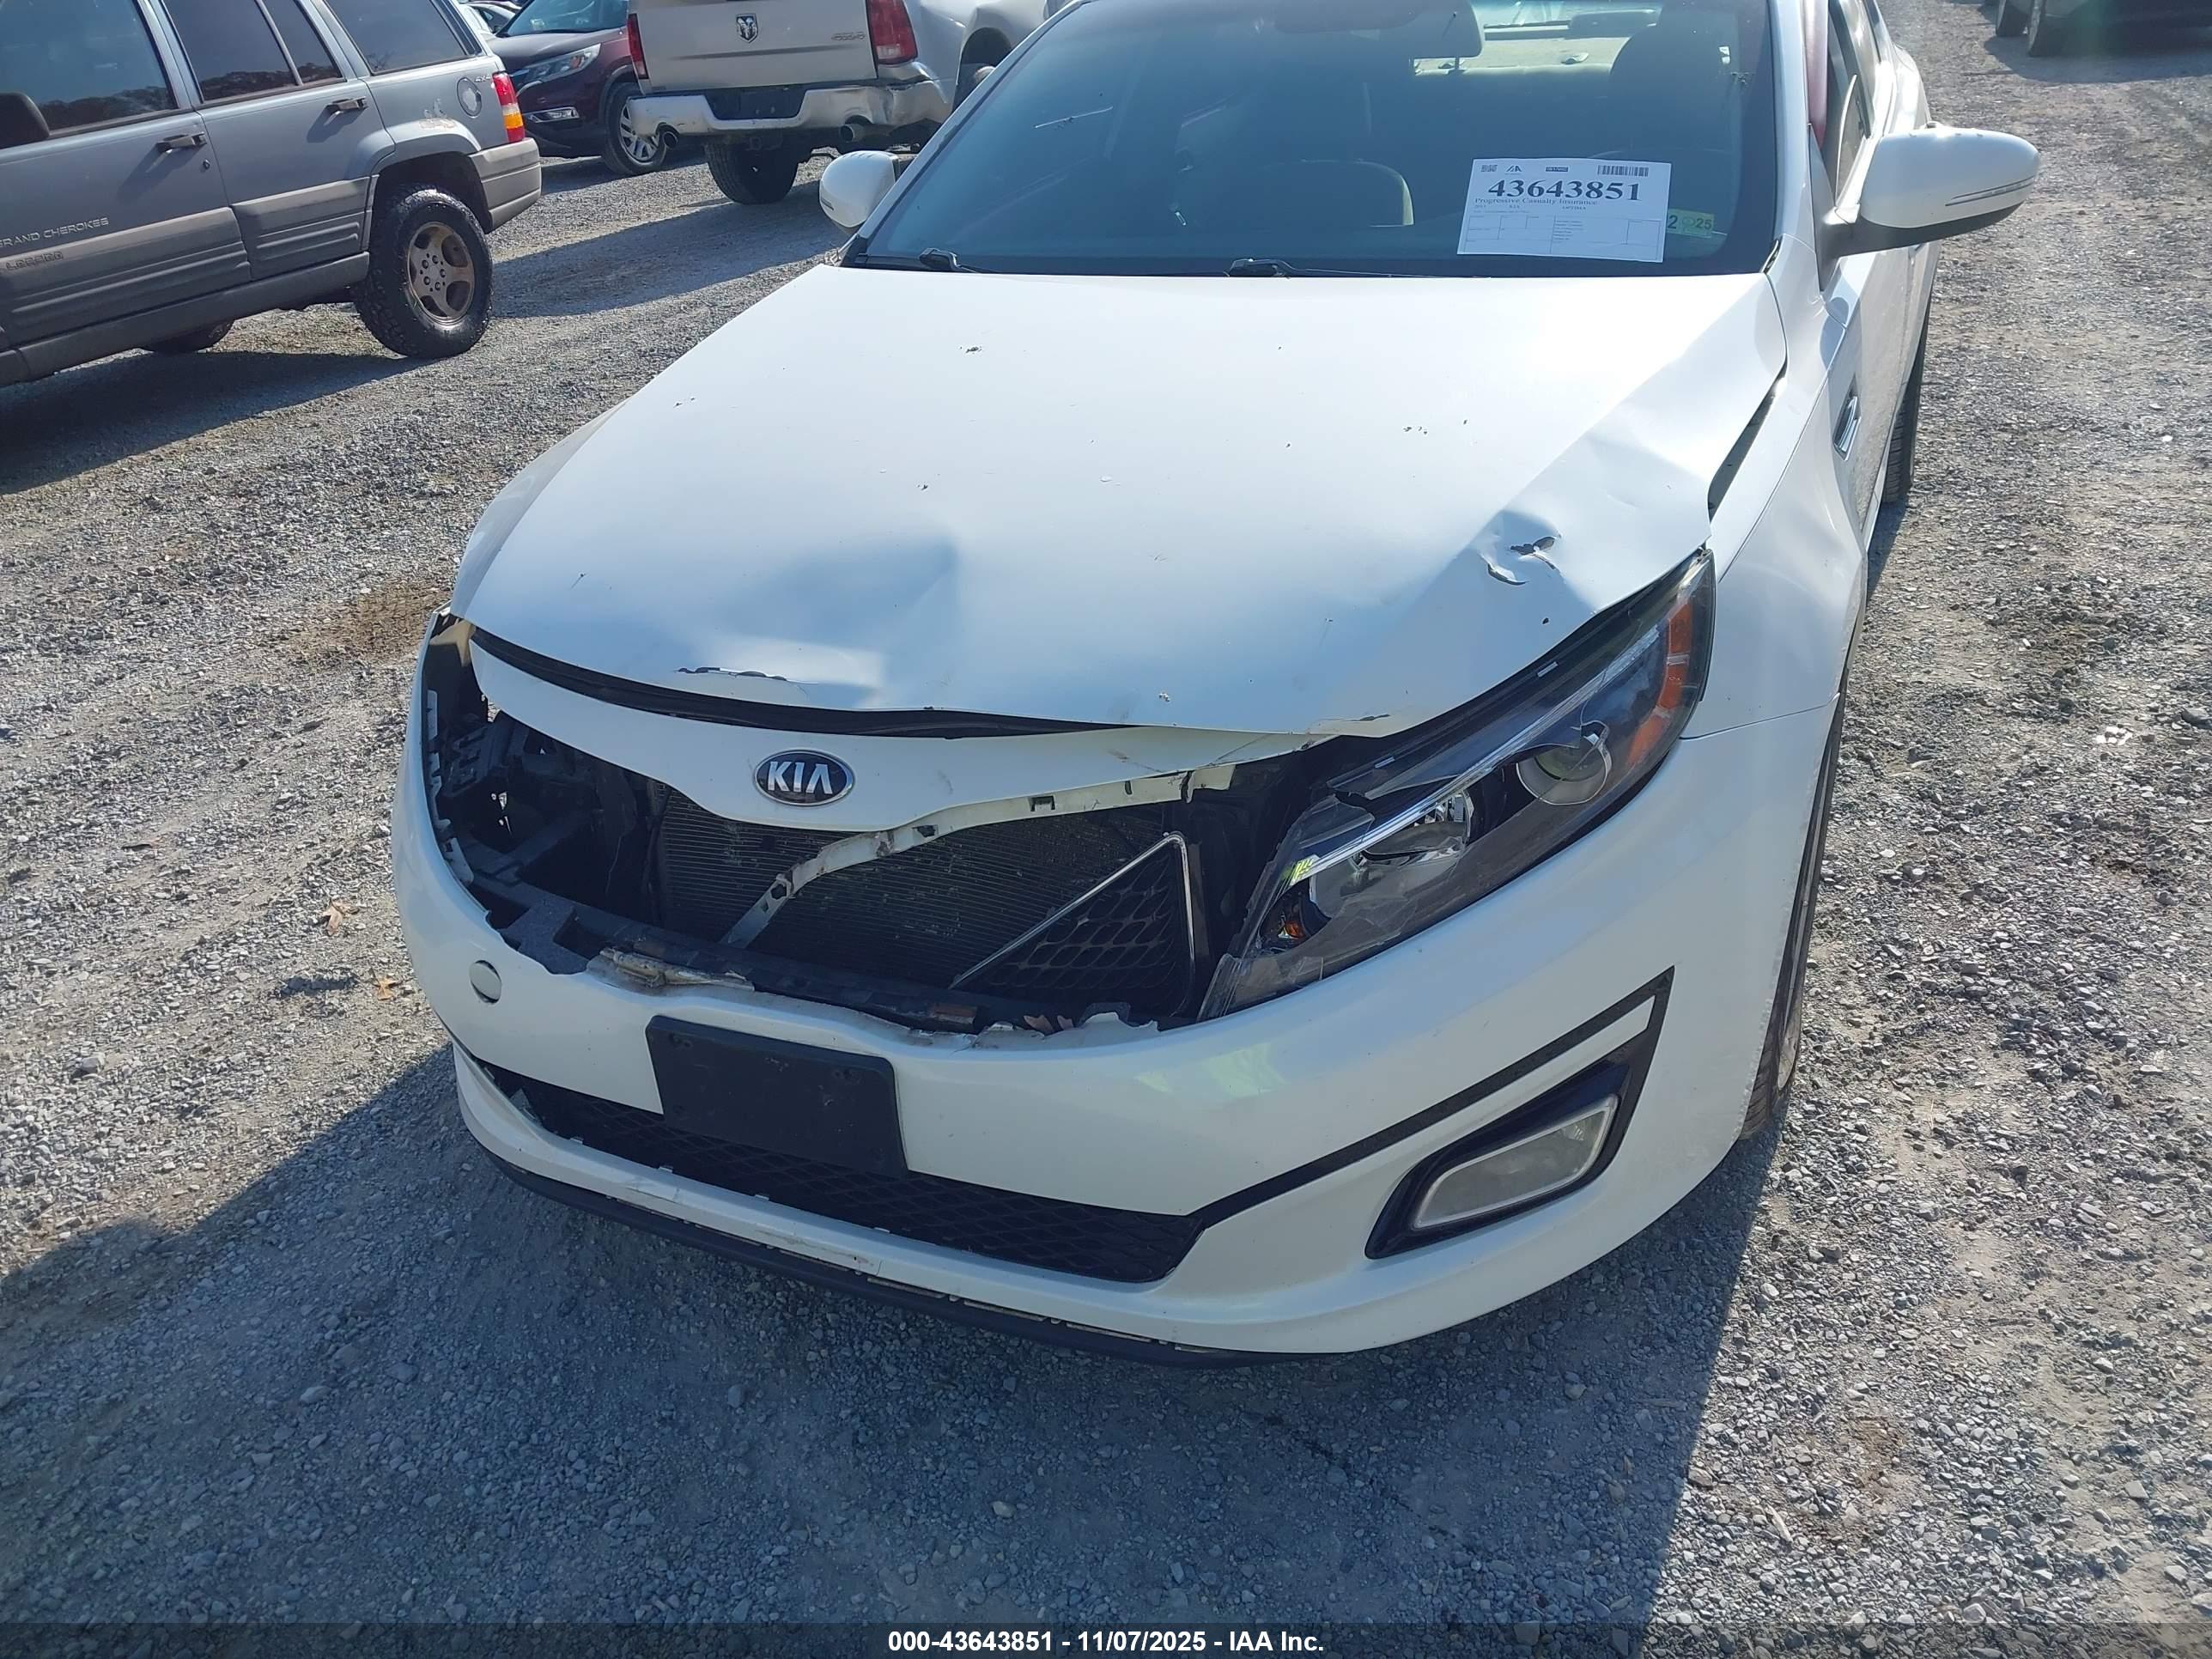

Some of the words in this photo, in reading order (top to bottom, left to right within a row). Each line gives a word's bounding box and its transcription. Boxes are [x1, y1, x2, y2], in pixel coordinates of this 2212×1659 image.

[1488, 179, 1642, 202] 43643851
[1696, 218, 1712, 230] 25
[767, 761, 833, 794] KIA
